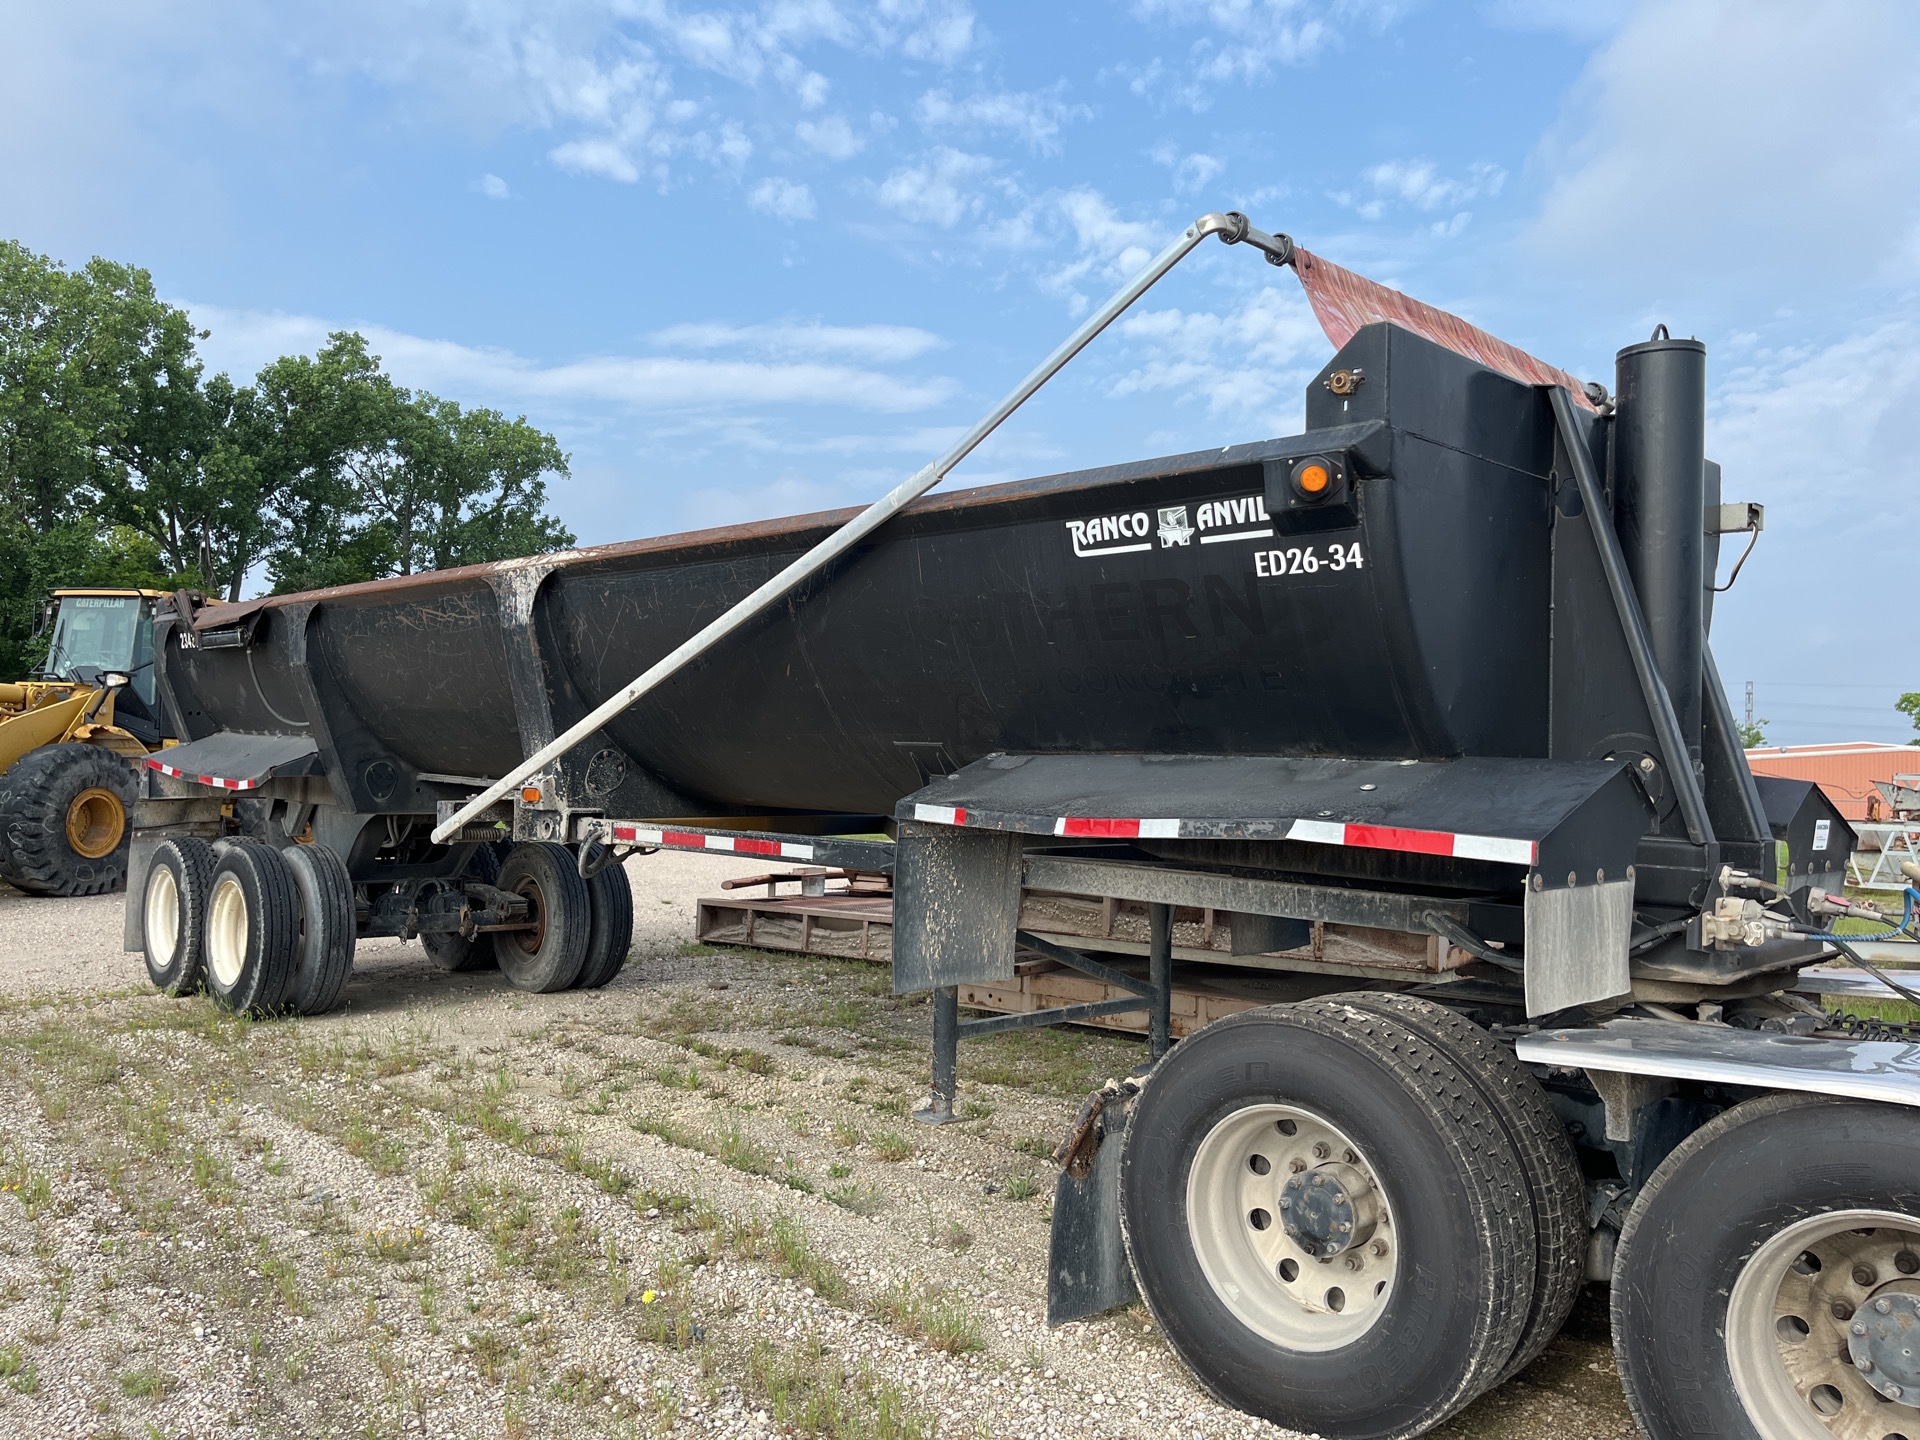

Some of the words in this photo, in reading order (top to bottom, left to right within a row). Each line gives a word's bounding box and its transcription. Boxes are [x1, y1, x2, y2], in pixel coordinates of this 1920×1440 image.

[1066, 512, 1152, 553] RANCO
[1196, 496, 1271, 531] ANVIL
[1253, 542, 1365, 578] ED26-34
[76, 598, 125, 609] CATERPILLAR
